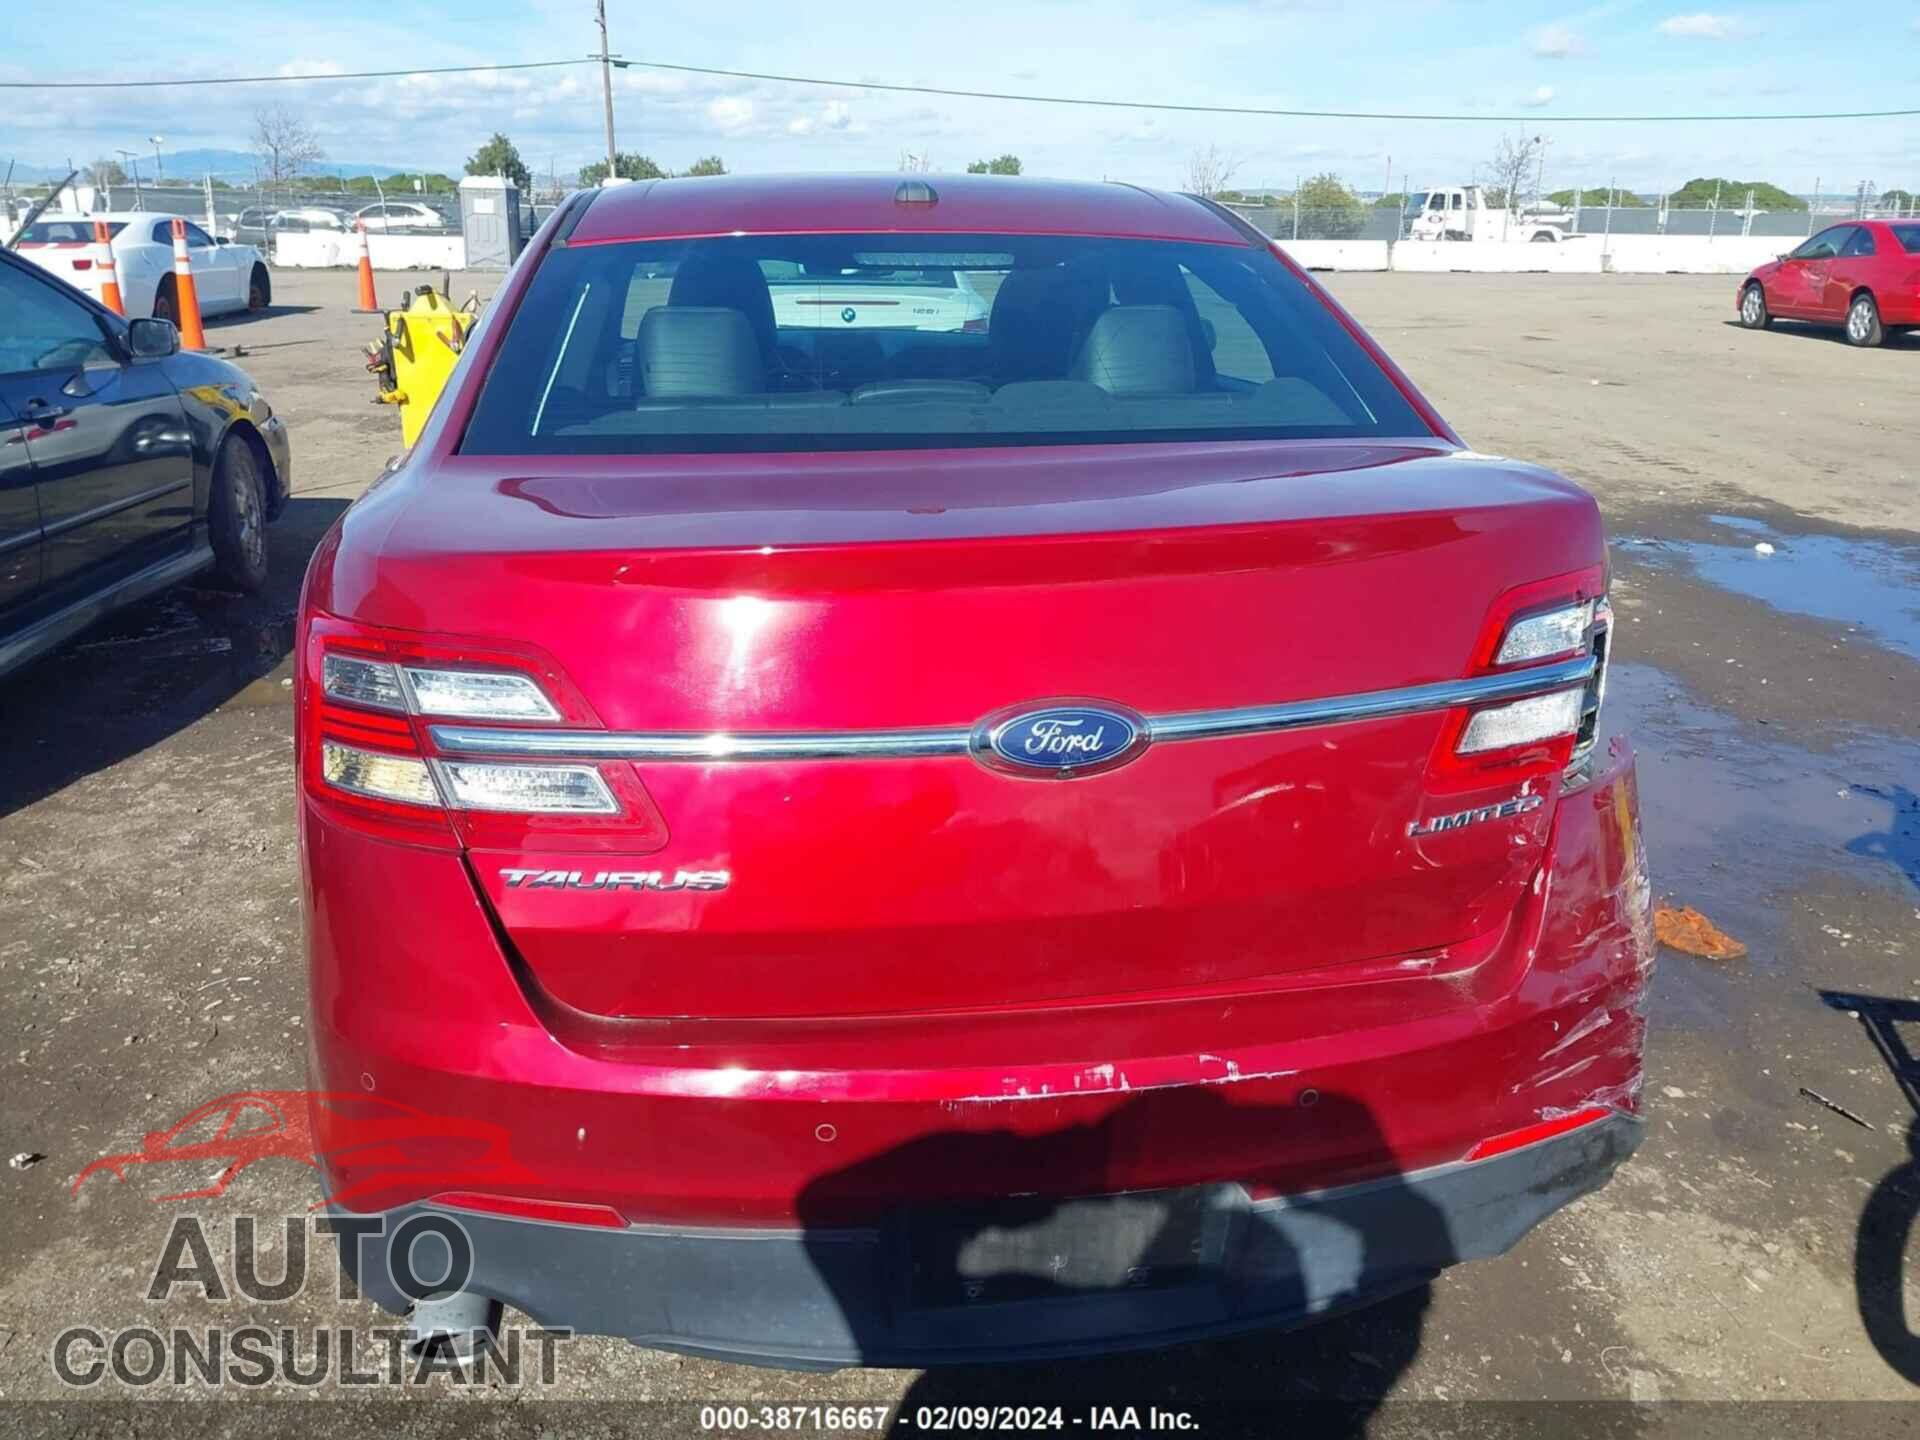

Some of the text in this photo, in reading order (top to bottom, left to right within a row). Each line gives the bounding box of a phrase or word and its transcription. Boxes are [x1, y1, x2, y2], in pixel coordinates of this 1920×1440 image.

[1025, 719, 1104, 755] Ford
[1406, 795, 1543, 836] LIMITED
[498, 867, 731, 892] TAURUS
